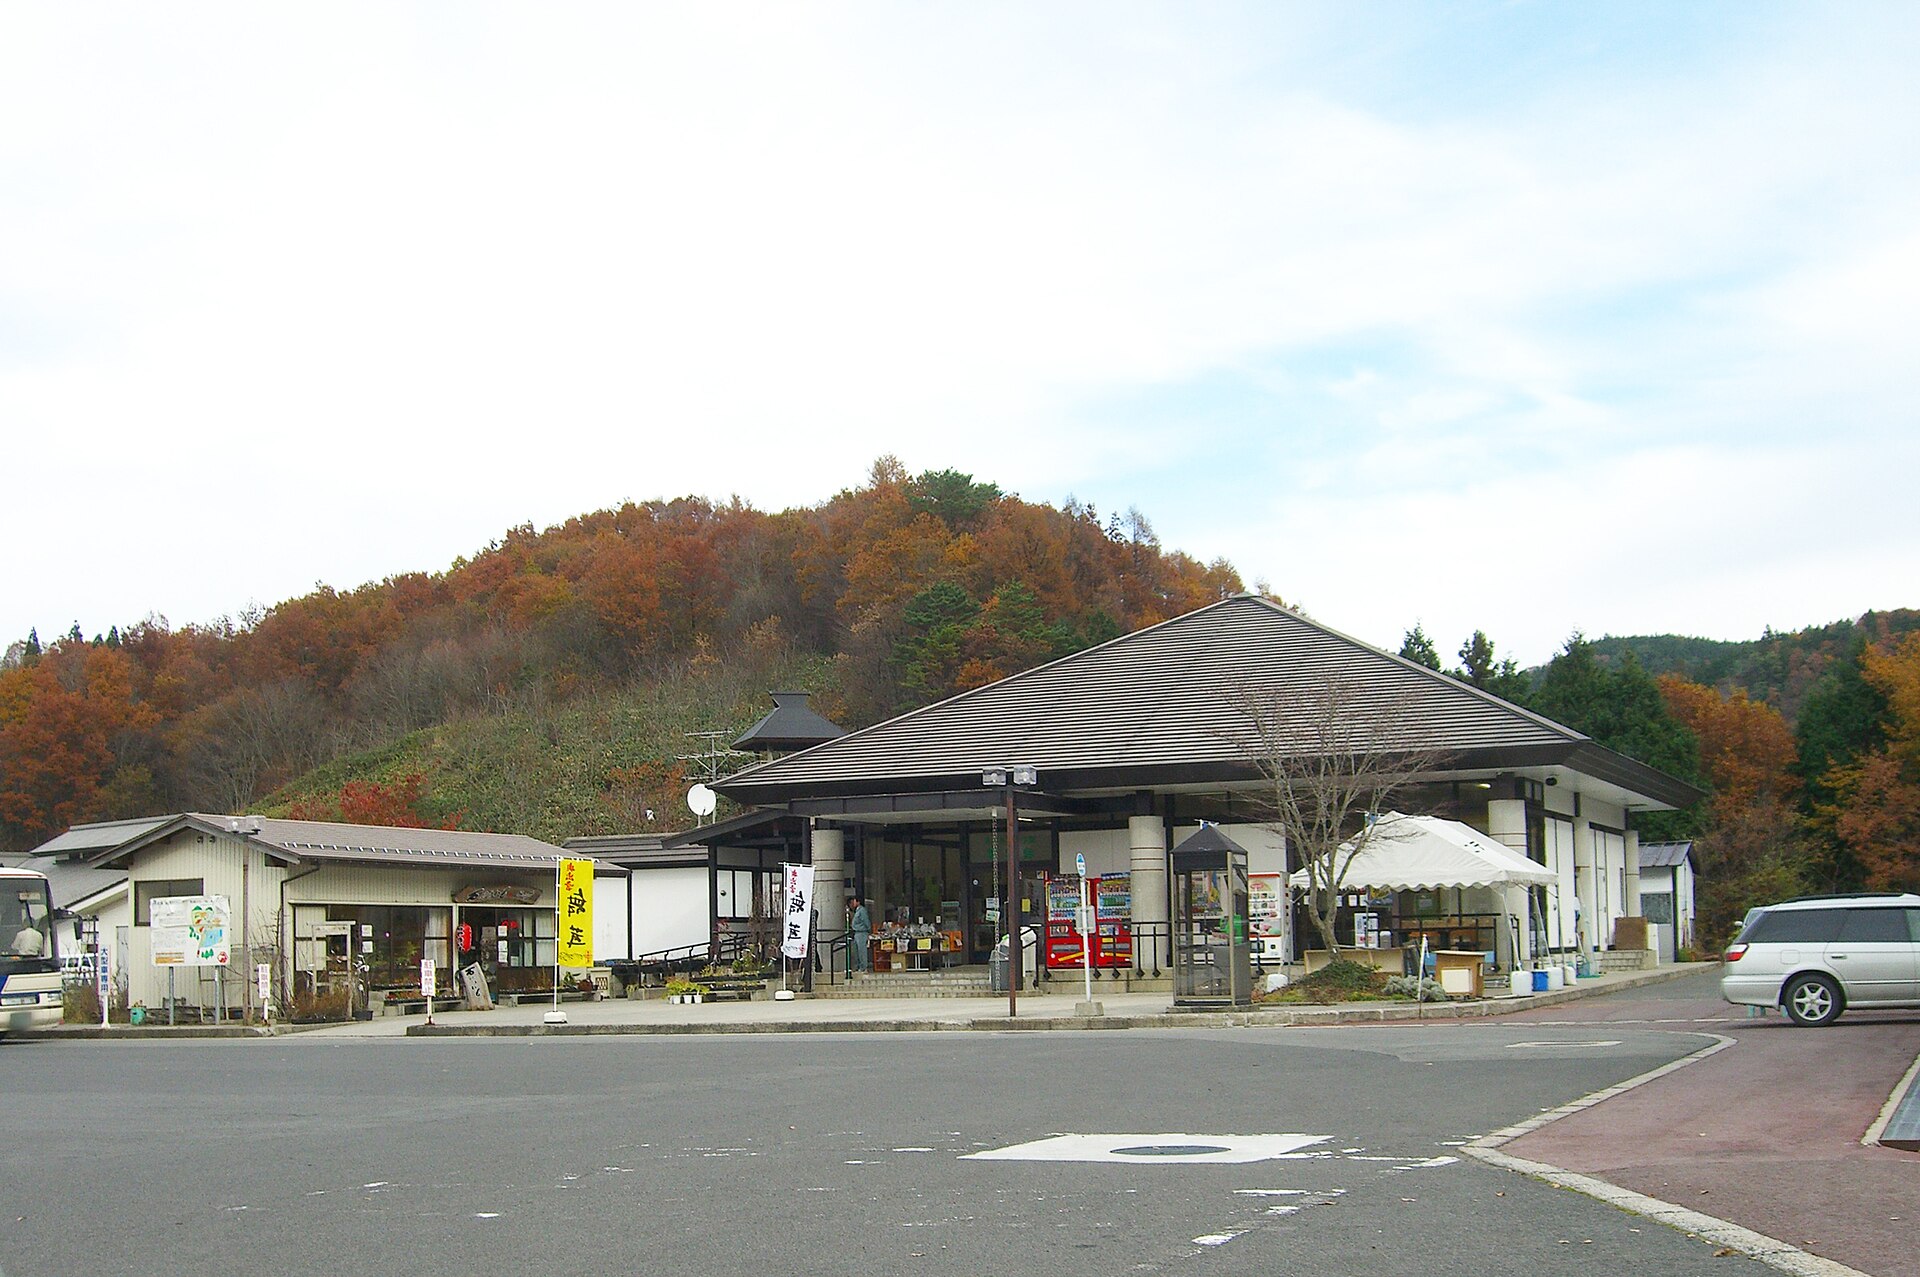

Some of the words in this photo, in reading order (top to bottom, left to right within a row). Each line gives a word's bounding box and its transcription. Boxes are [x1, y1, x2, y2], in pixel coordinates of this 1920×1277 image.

[100, 948, 109, 992] 大型車専用
